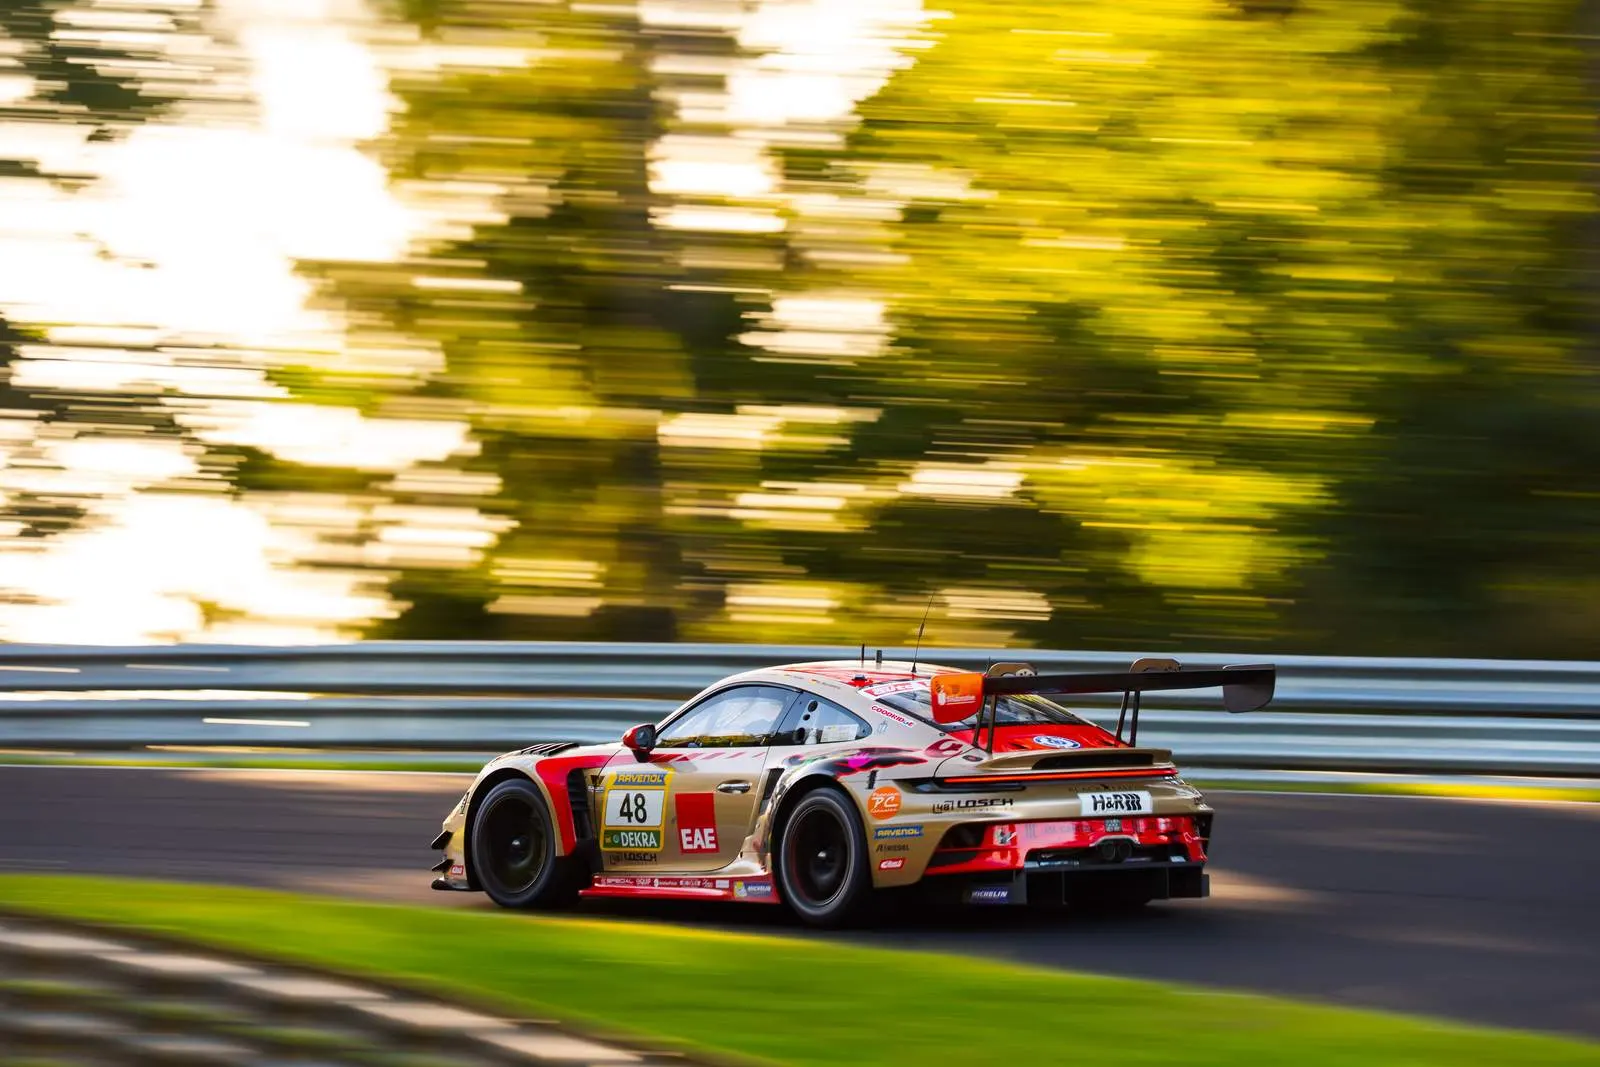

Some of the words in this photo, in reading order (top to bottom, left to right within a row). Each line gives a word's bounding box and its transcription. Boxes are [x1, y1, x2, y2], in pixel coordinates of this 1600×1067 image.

[617, 774, 662, 783] RAVENOL
[620, 793, 647, 823] 48
[871, 796, 898, 809] PC
[957, 798, 1014, 808] LOSCH
[621, 831, 658, 847] DEKRA
[681, 828, 716, 849] EAE
[877, 828, 920, 837] RAVENOL
